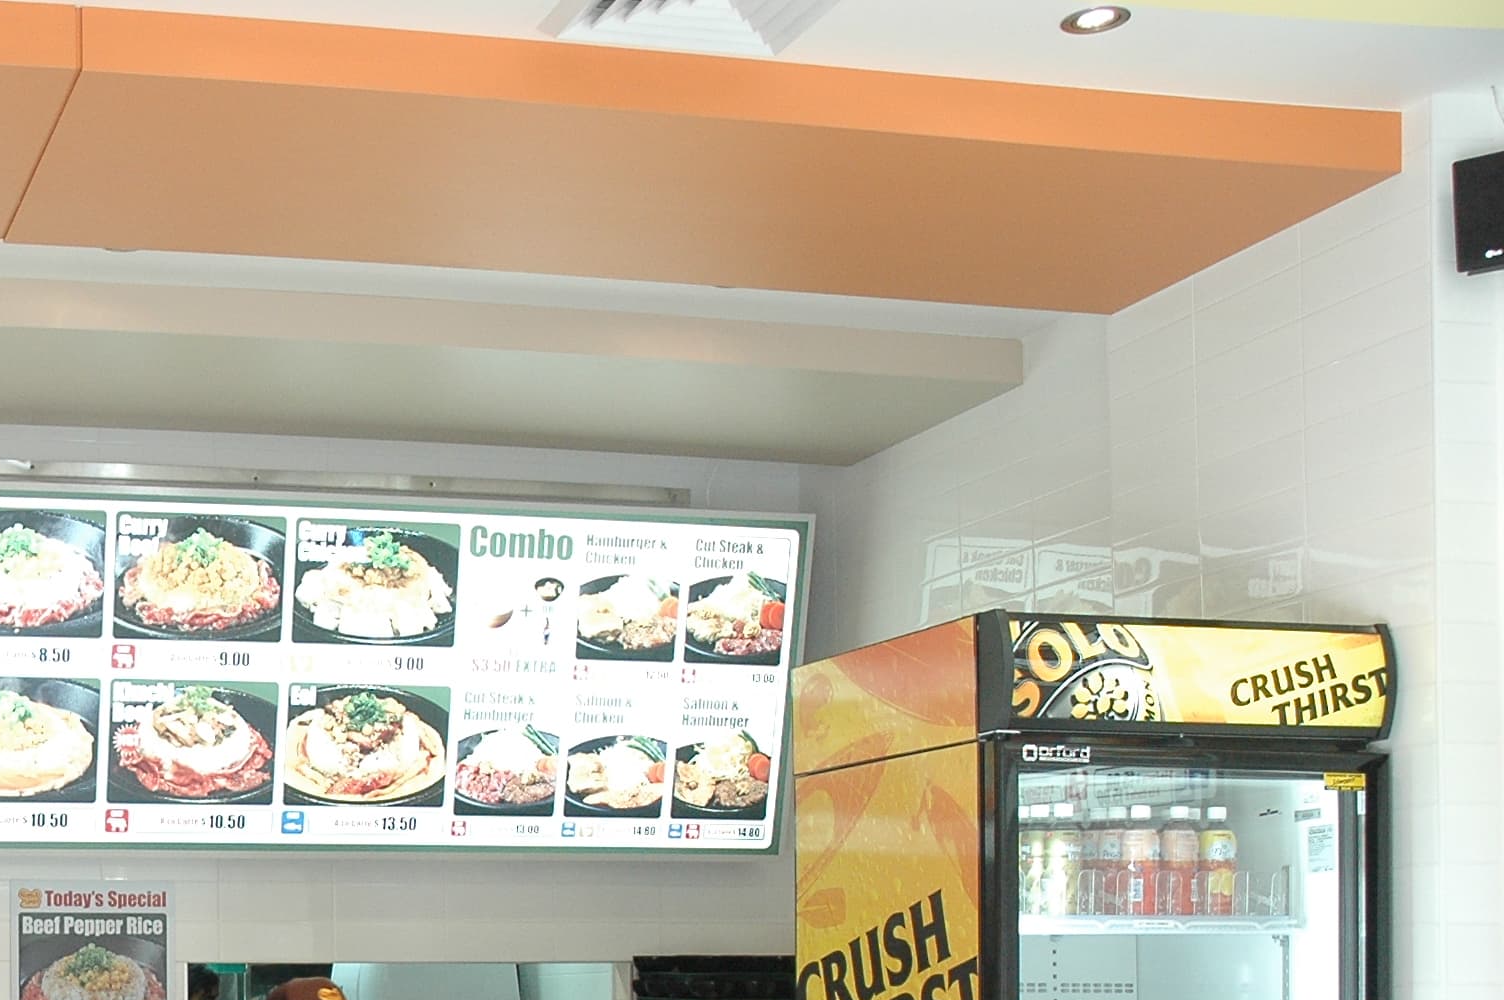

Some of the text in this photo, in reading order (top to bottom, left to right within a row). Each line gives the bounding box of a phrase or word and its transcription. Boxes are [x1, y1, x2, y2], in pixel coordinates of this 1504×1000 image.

[469, 525, 575, 561] Combo
[586, 534, 656, 552] Hamburger
[696, 538, 765, 555] Cut Steak &
[694, 556, 744, 570] Chicken
[39, 648, 70, 662] 8.50
[219, 651, 250, 666] 9.00
[394, 656, 424, 670] 9.00
[1230, 654, 1338, 707] CRUSH
[464, 691, 488, 706] Cut
[490, 691, 524, 706] Steak
[575, 694, 622, 708] Salmon
[683, 697, 729, 711] Salmon
[1271, 667, 1388, 727] THIRST
[463, 708, 534, 724] Hamburger
[574, 711, 624, 725] Chicken
[681, 714, 750, 730] Hamburger
[32, 813, 68, 828] 10.50
[210, 814, 245, 829] 10.50
[382, 816, 417, 831] 13.50
[45, 890, 104, 909] Today's
[108, 890, 167, 909] Special
[22, 916, 164, 937] Beef Pepper Rice
